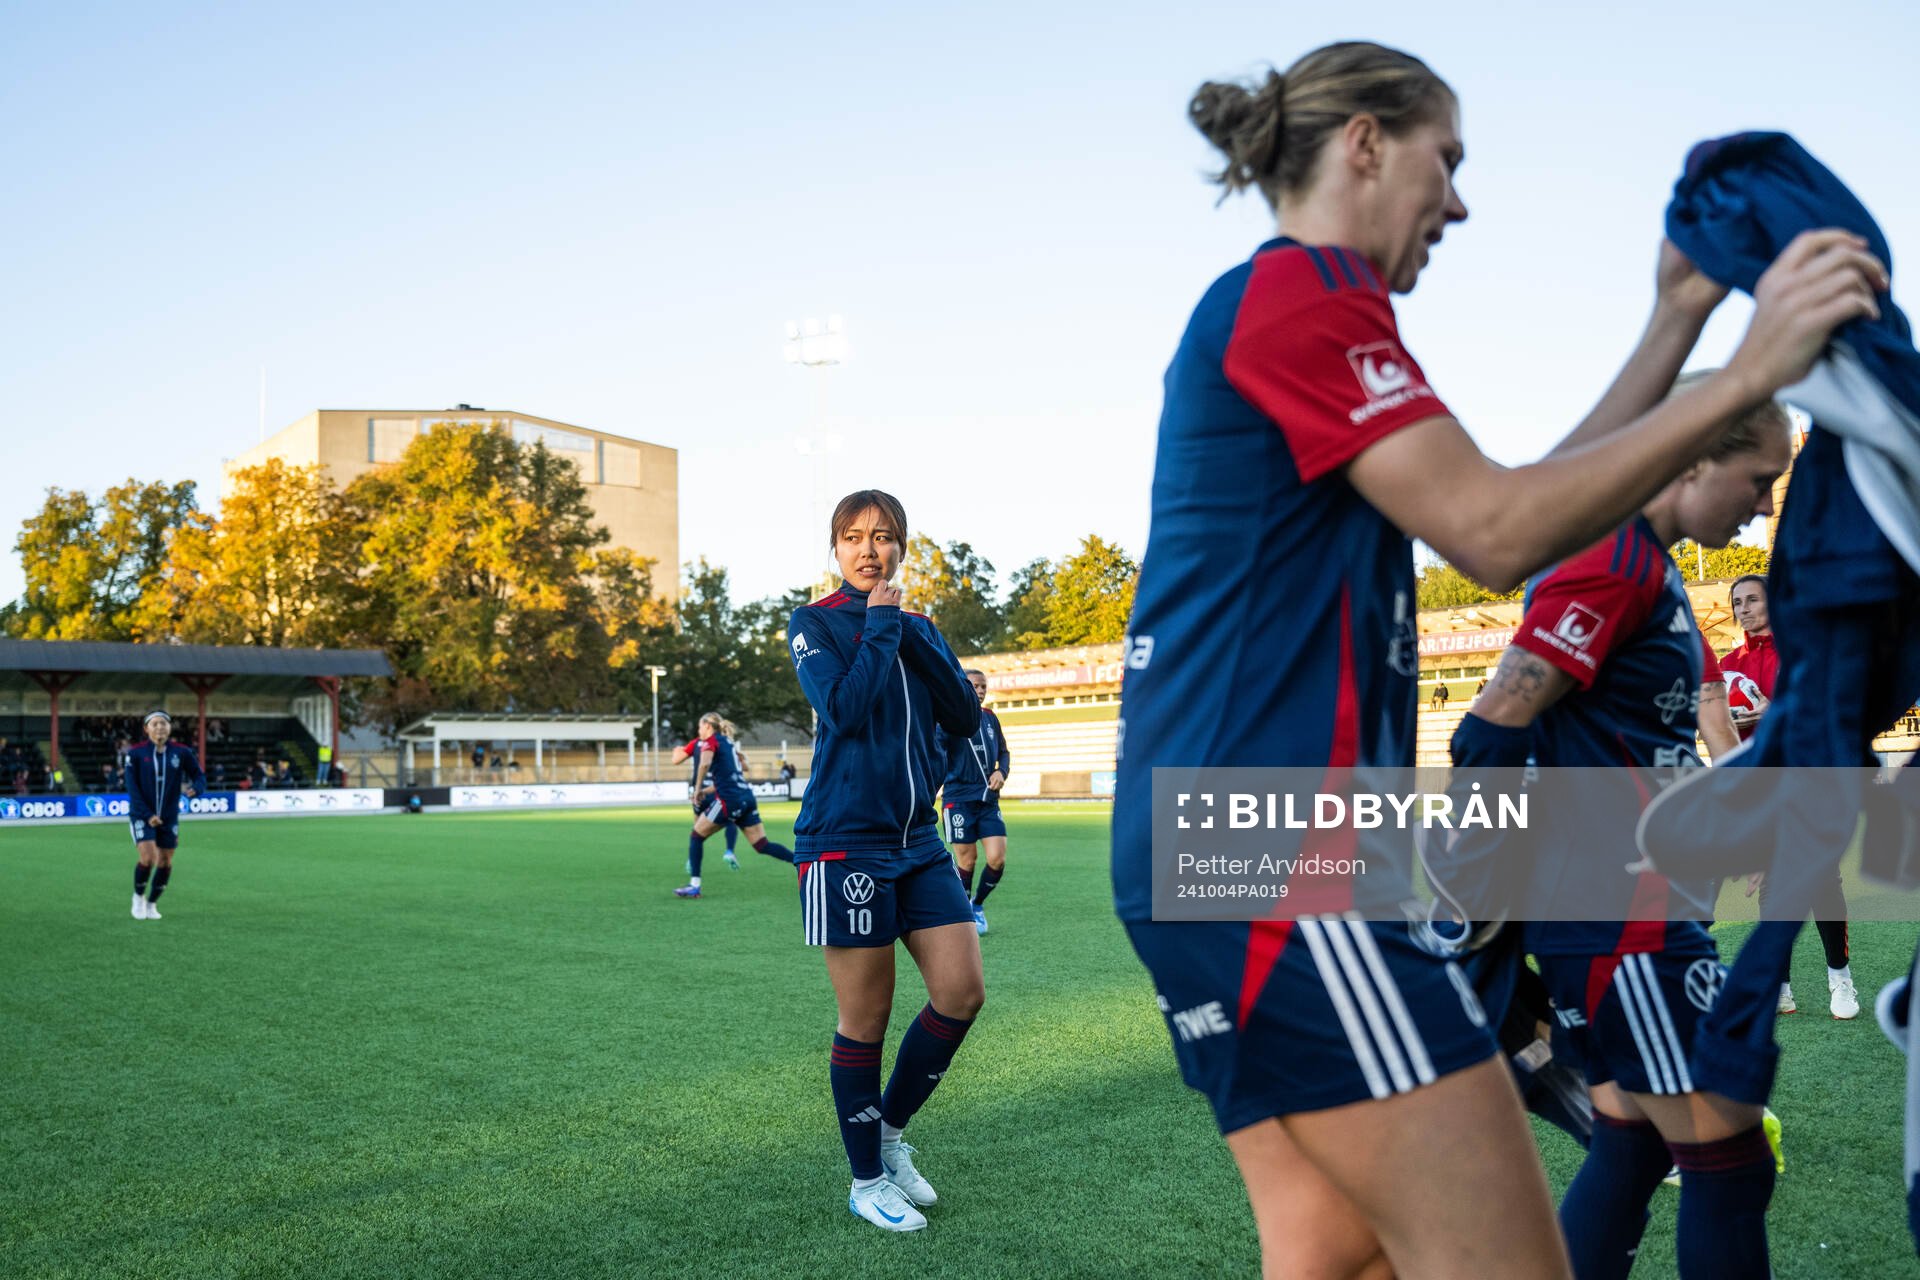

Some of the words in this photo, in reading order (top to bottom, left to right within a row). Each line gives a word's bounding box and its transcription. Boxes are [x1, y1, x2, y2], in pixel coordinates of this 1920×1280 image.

[1440, 631, 1514, 651] TJEJFOTB
[22, 801, 65, 818] OBOS
[108, 800, 130, 816] OB
[190, 797, 229, 813] OBOS
[954, 828, 965, 839] 15
[847, 908, 872, 935] 10
